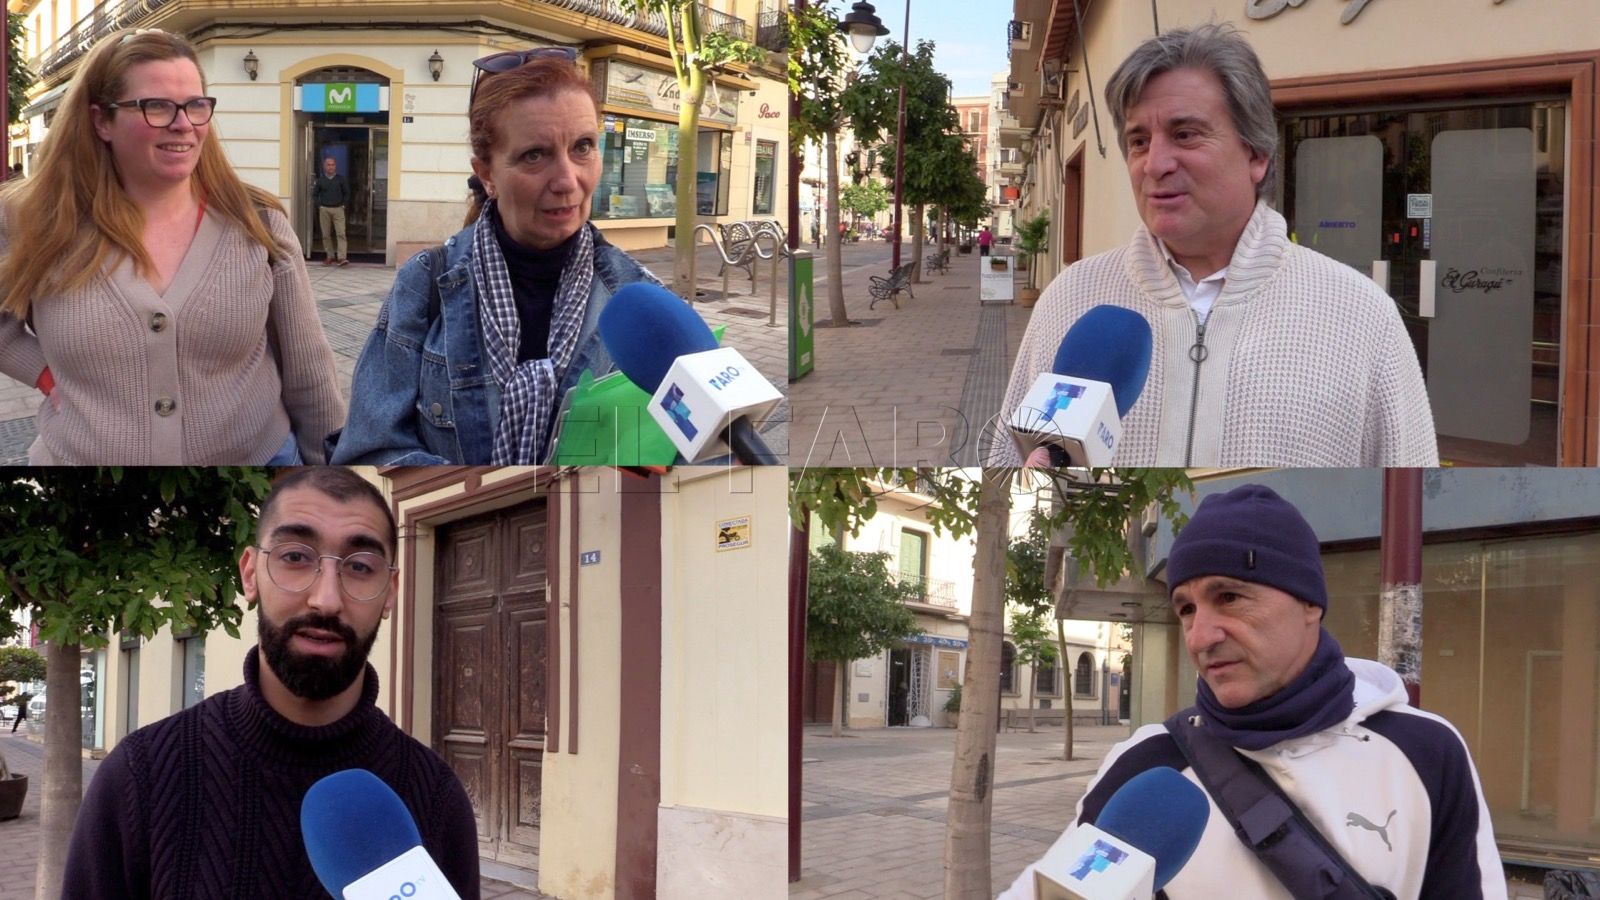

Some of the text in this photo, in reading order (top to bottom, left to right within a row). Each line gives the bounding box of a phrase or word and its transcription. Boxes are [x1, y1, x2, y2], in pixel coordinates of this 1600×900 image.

[758, 102, 781, 119] Paco
[627, 128, 655, 141] IMSERSO
[584, 552, 597, 563] 14
